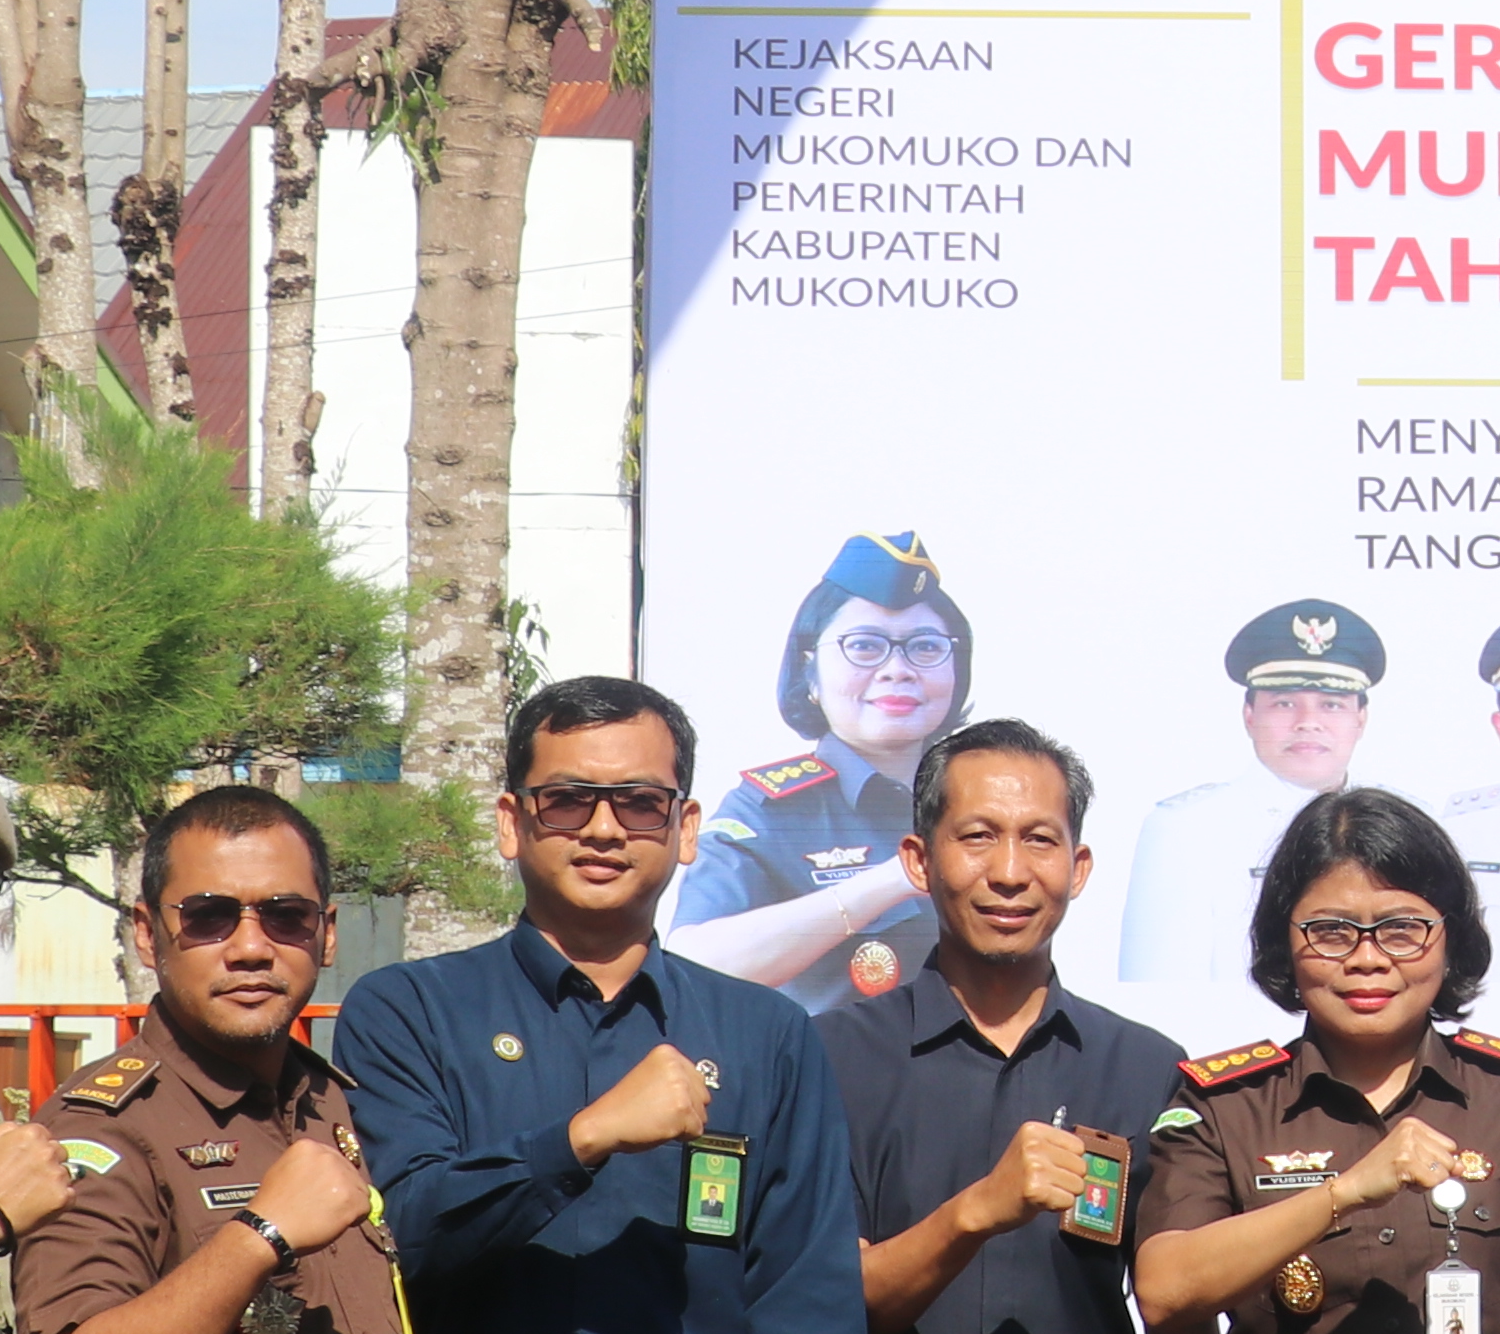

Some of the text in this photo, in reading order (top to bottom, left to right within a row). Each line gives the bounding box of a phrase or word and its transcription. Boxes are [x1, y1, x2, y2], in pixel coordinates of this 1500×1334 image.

[733, 38, 993, 71] KEJAKSAAN
[733, 85, 894, 118] NEGERI
[733, 134, 1132, 168] MUKOMUKO DAN
[732, 181, 1024, 214] PEMERINTAH
[732, 228, 1000, 262] KABUPATEN
[732, 276, 1019, 309] MUKOMUKO
[1270, 1176, 1326, 1184] YUSTINA
